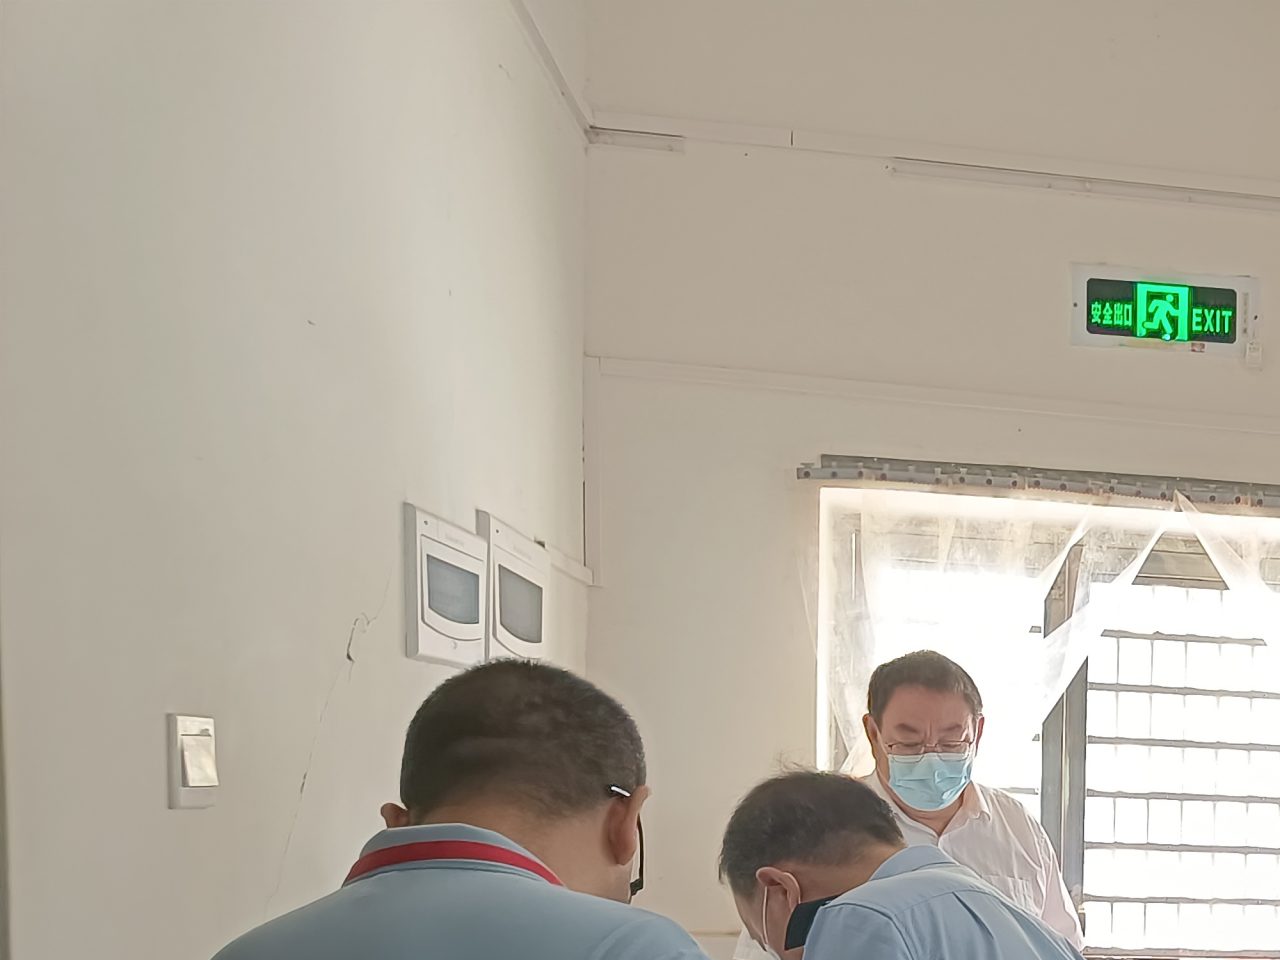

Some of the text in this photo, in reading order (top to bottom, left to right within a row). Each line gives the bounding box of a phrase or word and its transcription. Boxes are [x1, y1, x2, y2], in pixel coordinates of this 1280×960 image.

[1091, 301, 1133, 327] 安全出口
[1192, 307, 1233, 334] EXIT
